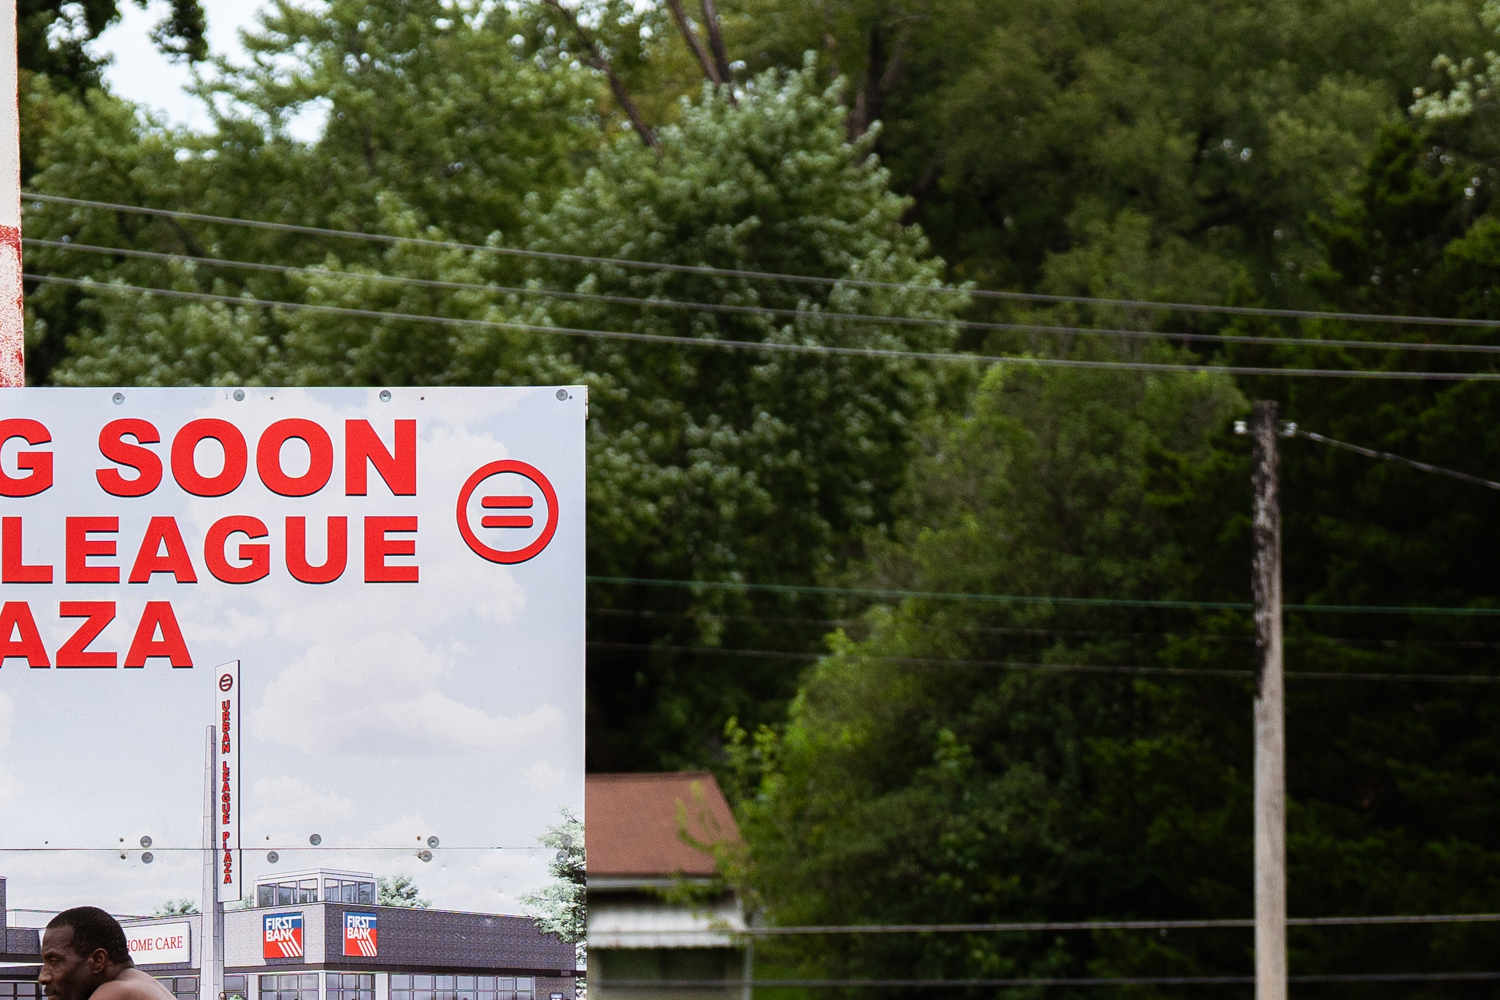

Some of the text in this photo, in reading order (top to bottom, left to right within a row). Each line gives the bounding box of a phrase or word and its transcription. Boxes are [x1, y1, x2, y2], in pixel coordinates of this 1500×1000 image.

[96, 417, 417, 498] SOON
[2, 515, 420, 585] LEAGUE
[222, 700, 233, 884] URBAN LEAGUE PLAZA
[265, 916, 300, 930] FIRST
[347, 915, 375, 929] FIRST
[265, 928, 294, 943] BANK
[347, 927, 372, 940] BANK
[155, 935, 183, 951] CARE
